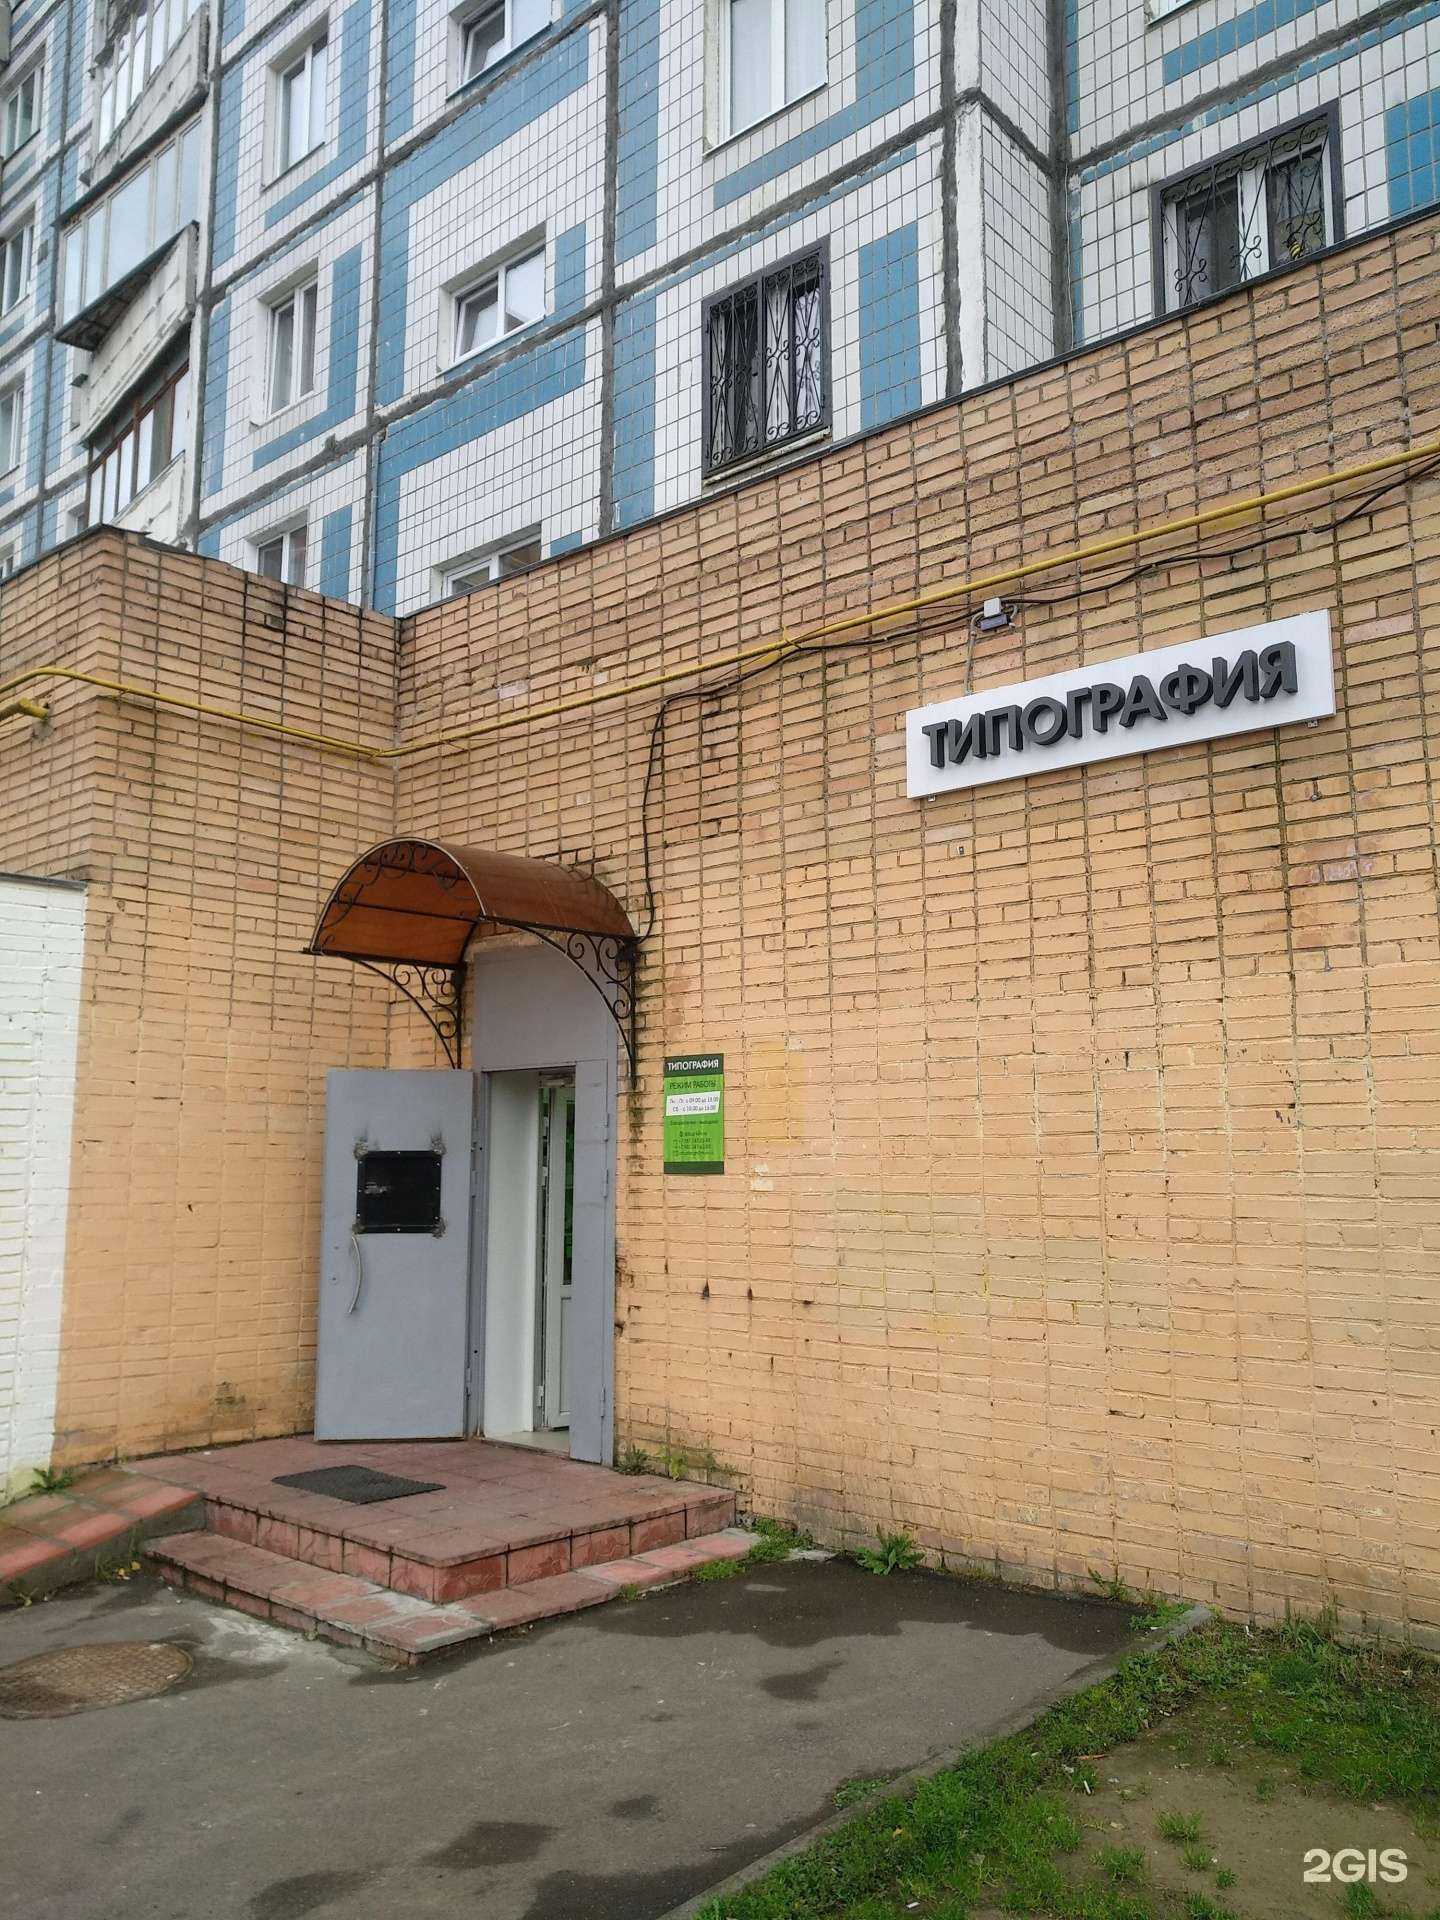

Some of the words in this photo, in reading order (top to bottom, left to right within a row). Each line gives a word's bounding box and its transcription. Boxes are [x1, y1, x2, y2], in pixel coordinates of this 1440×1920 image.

[922, 641, 1298, 768] ТИПОГРАФИЯ
[667, 1059, 719, 1071] ТИПОГРАФИЯ
[669, 1081, 692, 1090] РЕЖИМ
[692, 1080, 717, 1089] РАБОТЫ
